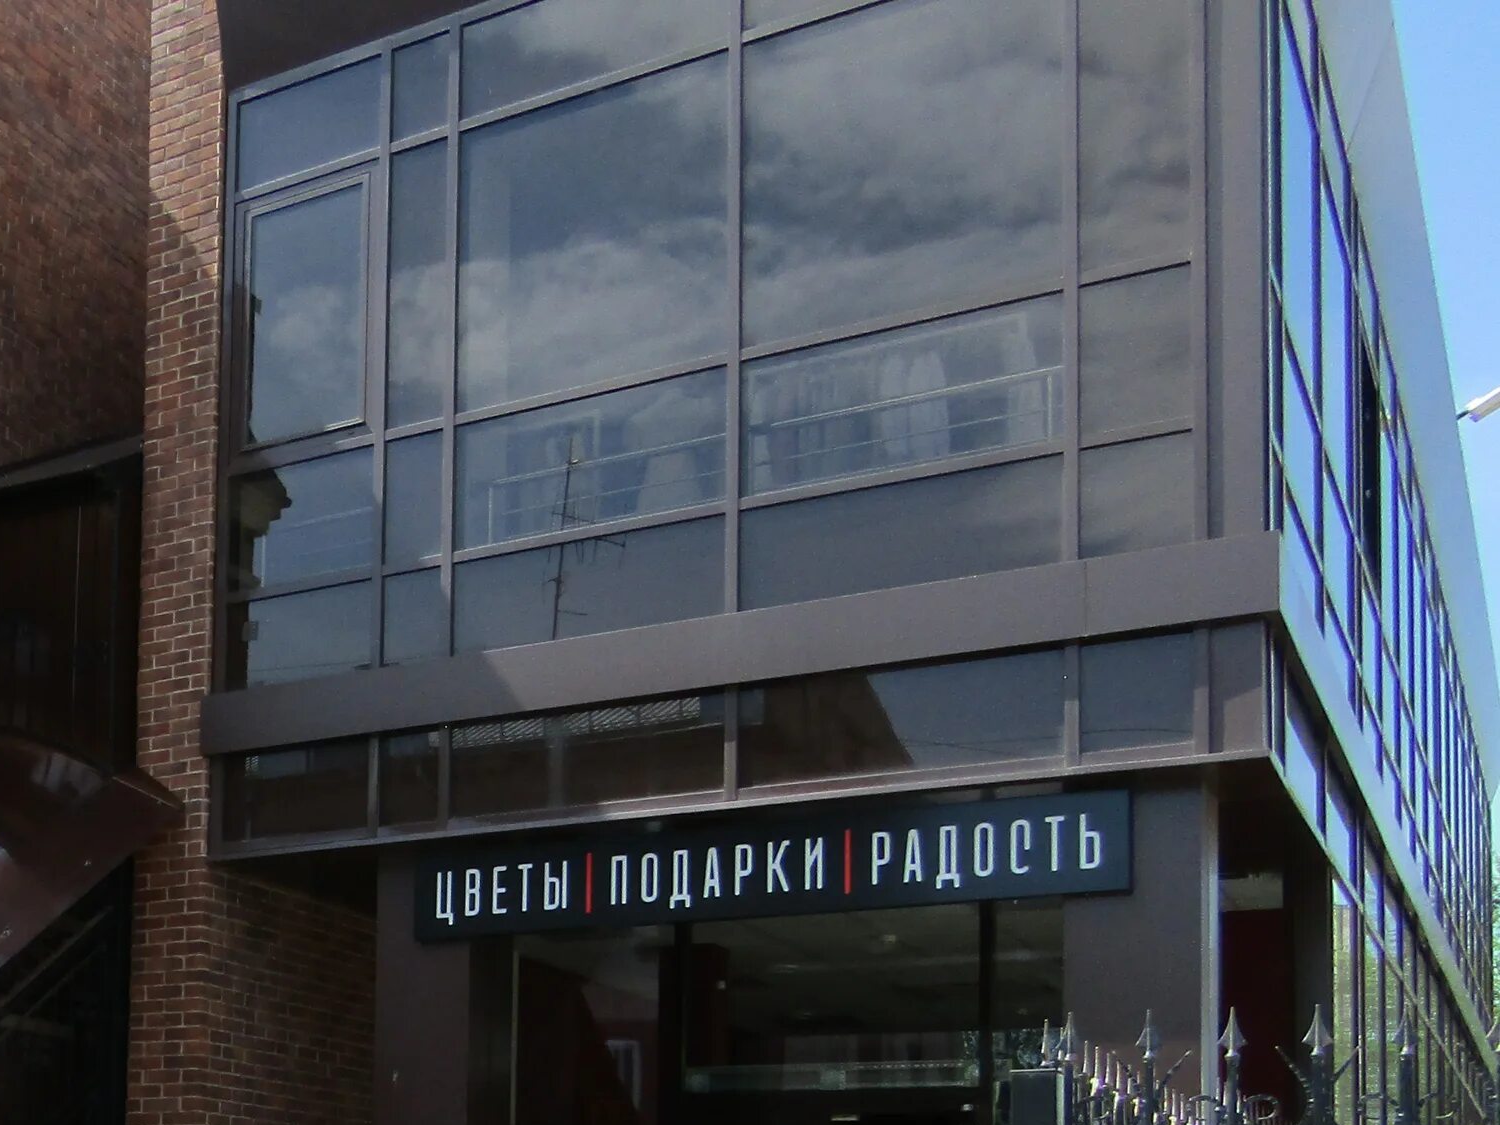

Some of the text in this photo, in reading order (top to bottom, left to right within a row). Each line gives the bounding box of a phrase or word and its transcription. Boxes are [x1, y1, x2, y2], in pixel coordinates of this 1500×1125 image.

[436, 813, 1101, 925] ЦВЕТЫ ПОДАРКИ РАДОСТЬ
